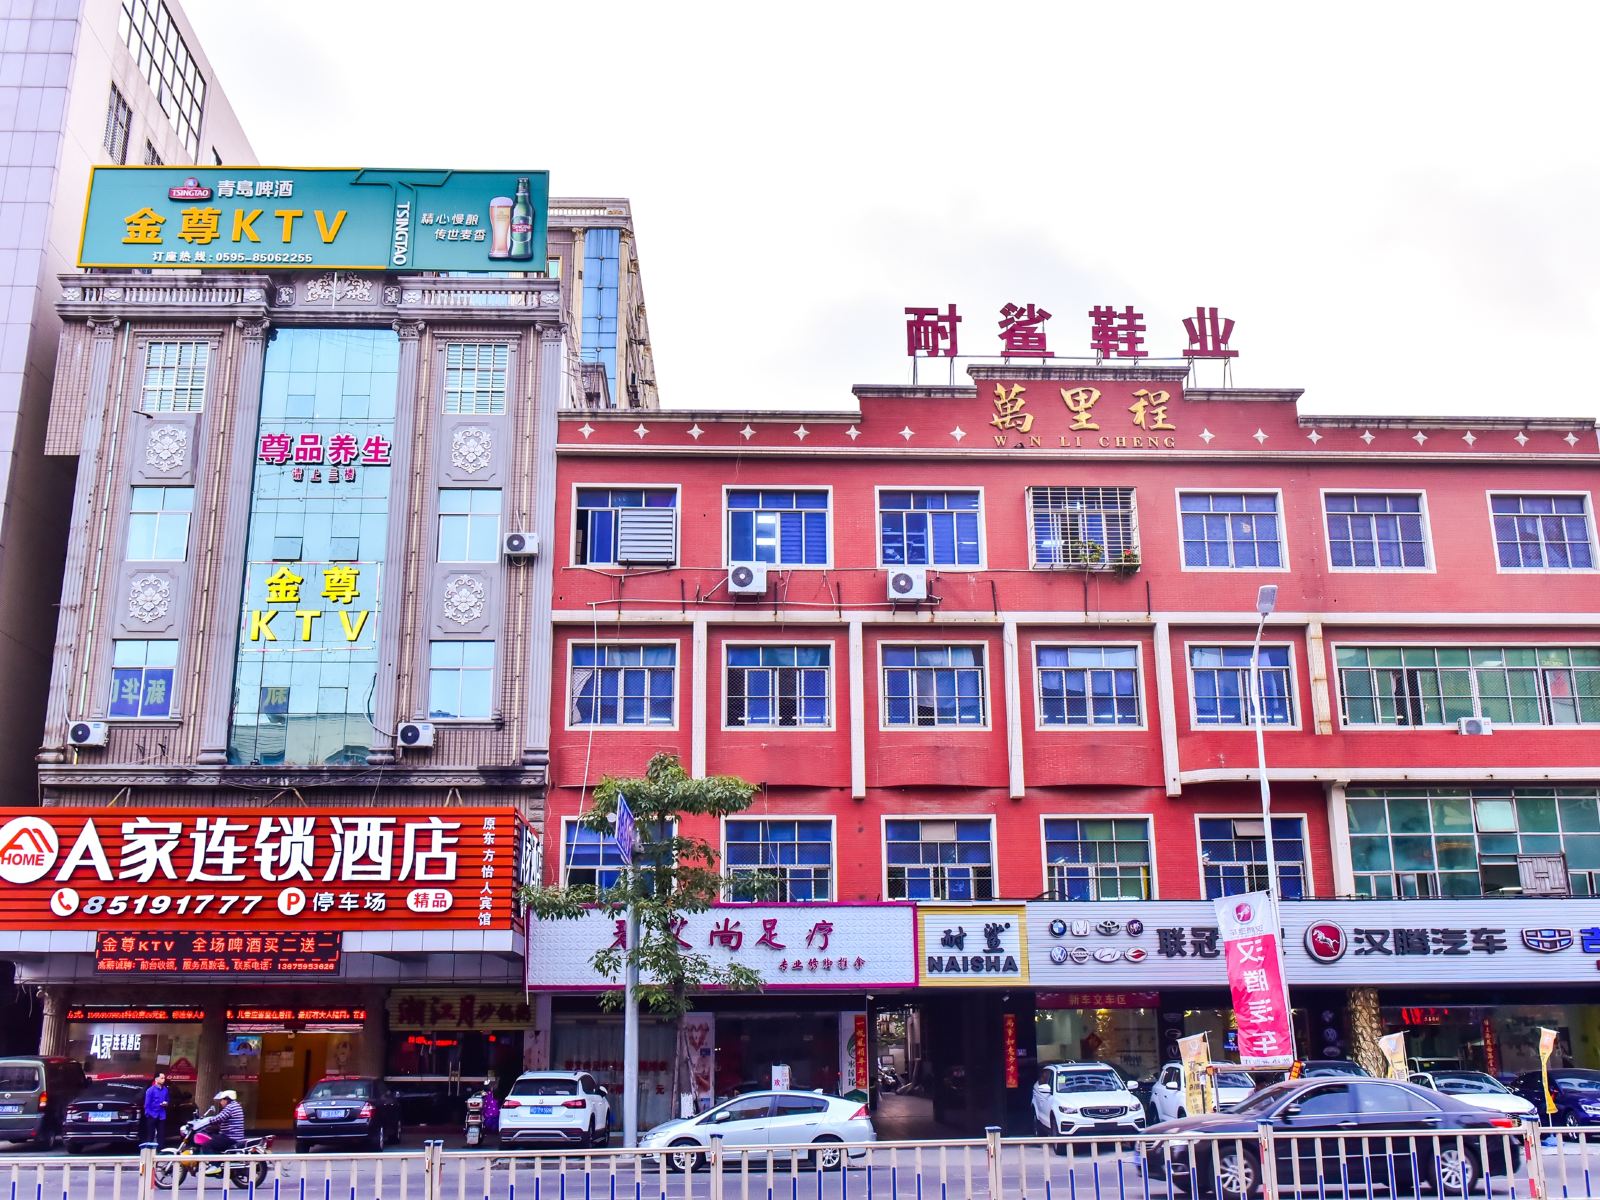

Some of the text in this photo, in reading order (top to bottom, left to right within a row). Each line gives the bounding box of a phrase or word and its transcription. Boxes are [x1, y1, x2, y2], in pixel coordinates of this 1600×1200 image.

[172, 189, 209, 197] TSINGTAO
[217, 180, 293, 197] 青岛啤酒
[420, 213, 479, 226] 精心慢酿
[393, 201, 410, 265] TSINGTAO
[435, 229, 486, 242] 传世麦香
[905, 303, 1239, 359] 耐鲨鞋业
[989, 382, 1176, 434] 萬里程
[258, 433, 391, 465] 尊品养生
[993, 435, 1176, 448] WN LI CHENG
[264, 565, 360, 603] 金尊
[250, 610, 369, 642] KTV
[0, 854, 45, 866] HOME
[54, 816, 461, 883] A家连锁酒店
[477, 817, 497, 927] 原东方怡人宾馆
[82, 895, 263, 915] 85191777
[312, 892, 386, 912] 停车场
[413, 891, 448, 909] 精品
[102, 937, 333, 953] 金尊KTV 全场啤酒买二送一
[941, 923, 1005, 953] 耐鲨
[1354, 928, 1508, 956] 汉腾汽车
[928, 955, 1018, 973] NAISHA
